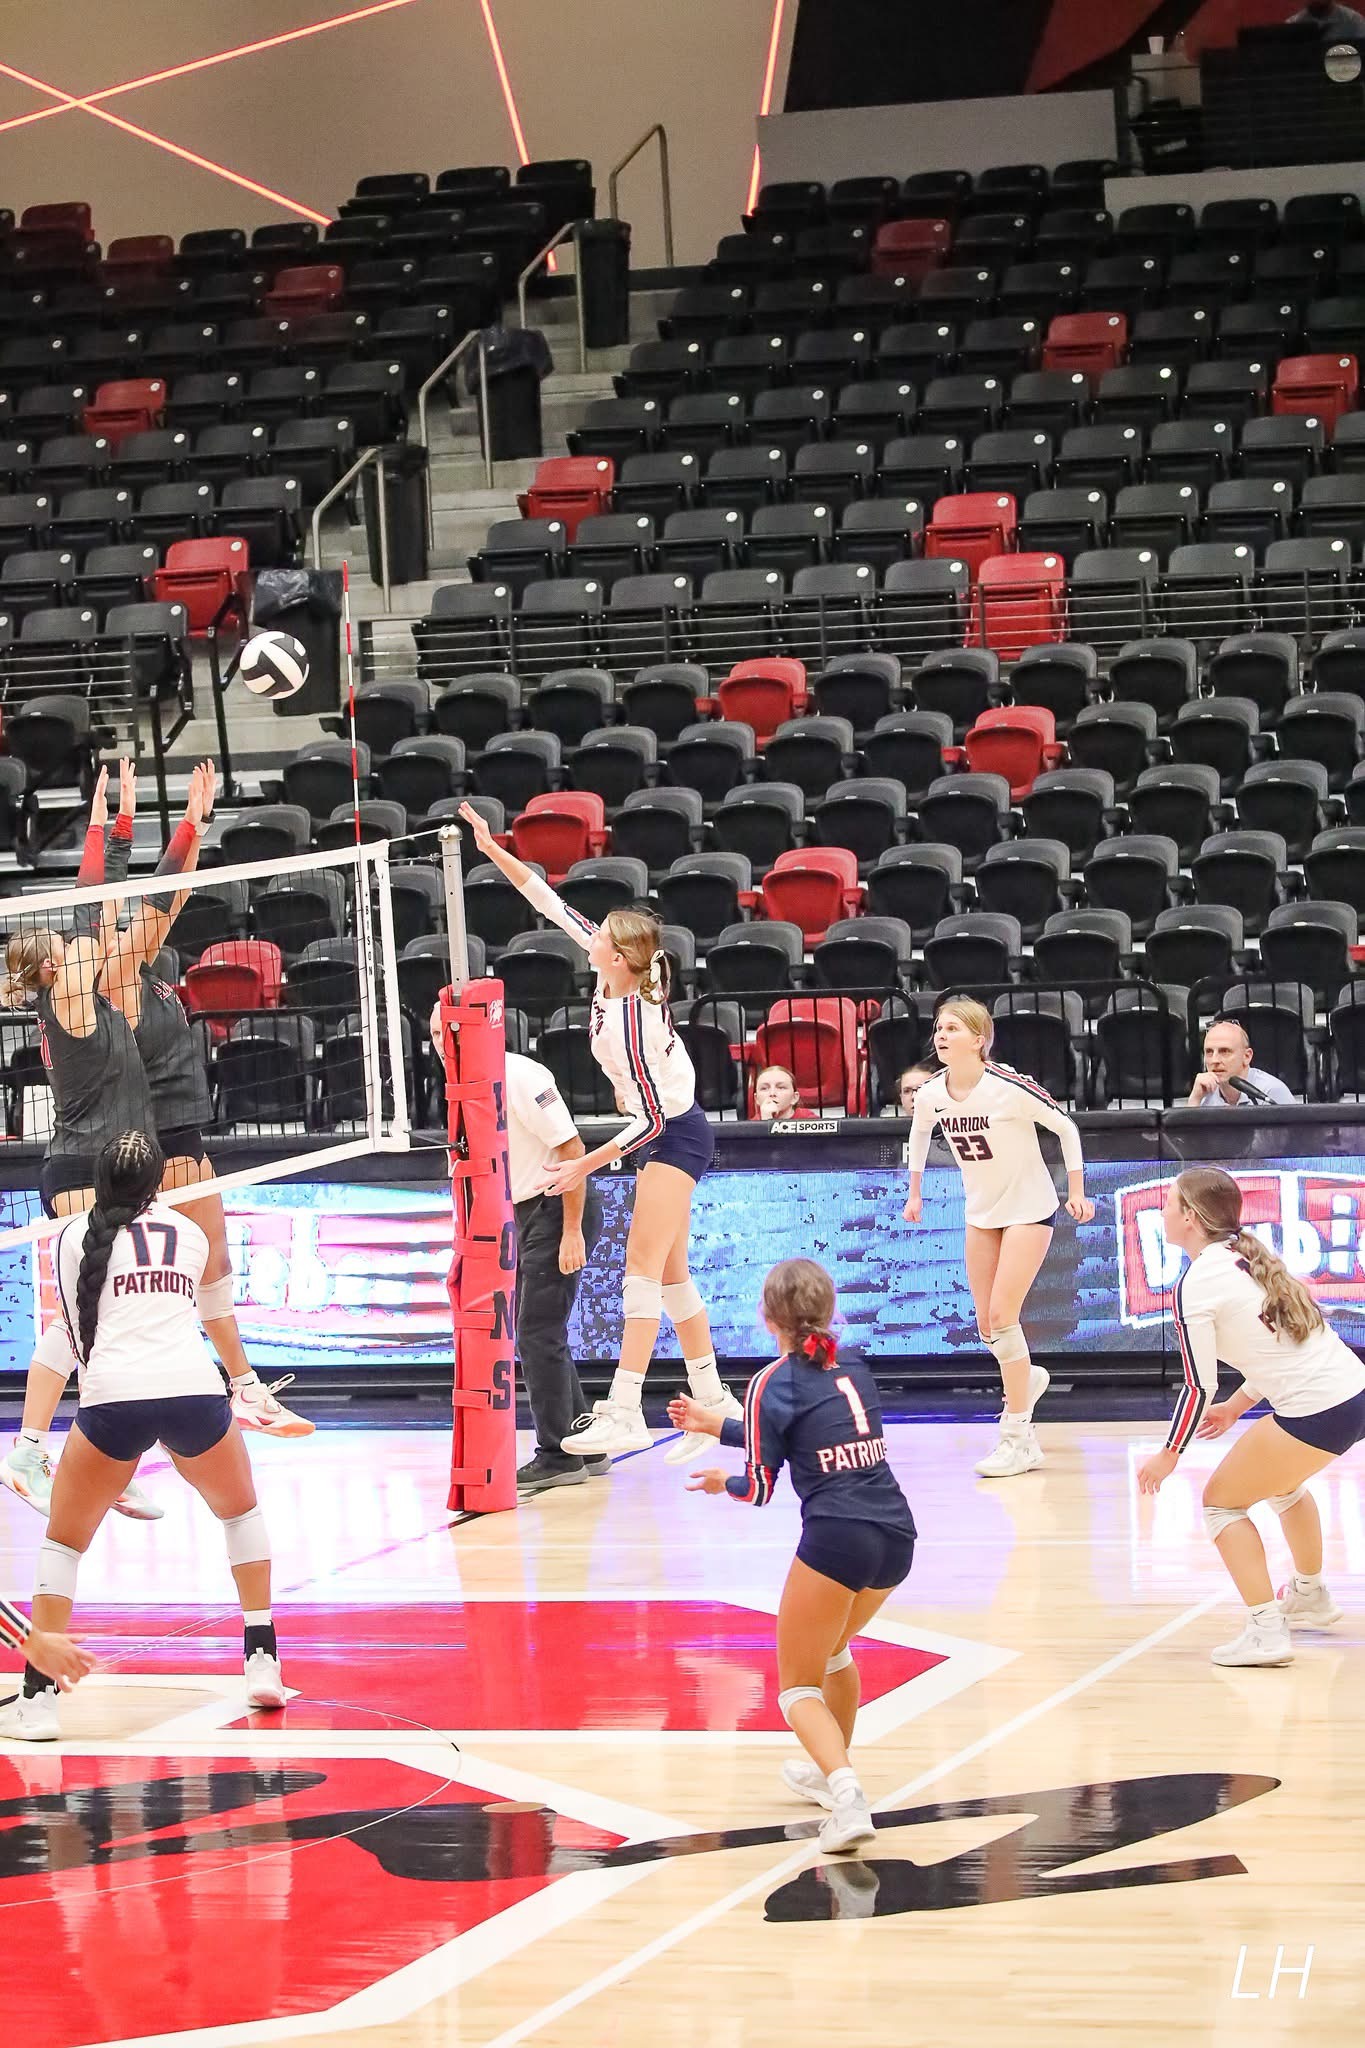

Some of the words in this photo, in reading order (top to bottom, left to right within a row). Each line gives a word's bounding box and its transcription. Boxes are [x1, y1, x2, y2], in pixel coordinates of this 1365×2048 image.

[365, 905, 373, 976] BISON
[771, 1121, 797, 1134] ACE
[799, 1123, 835, 1131] SPORTS
[941, 1116, 990, 1133] MARION
[951, 1134, 994, 1161] 23
[126, 1222, 178, 1267] 17
[490, 1082, 517, 1410] LIONS
[113, 1270, 194, 1300] PATRIOTS
[835, 1375, 870, 1436] 1
